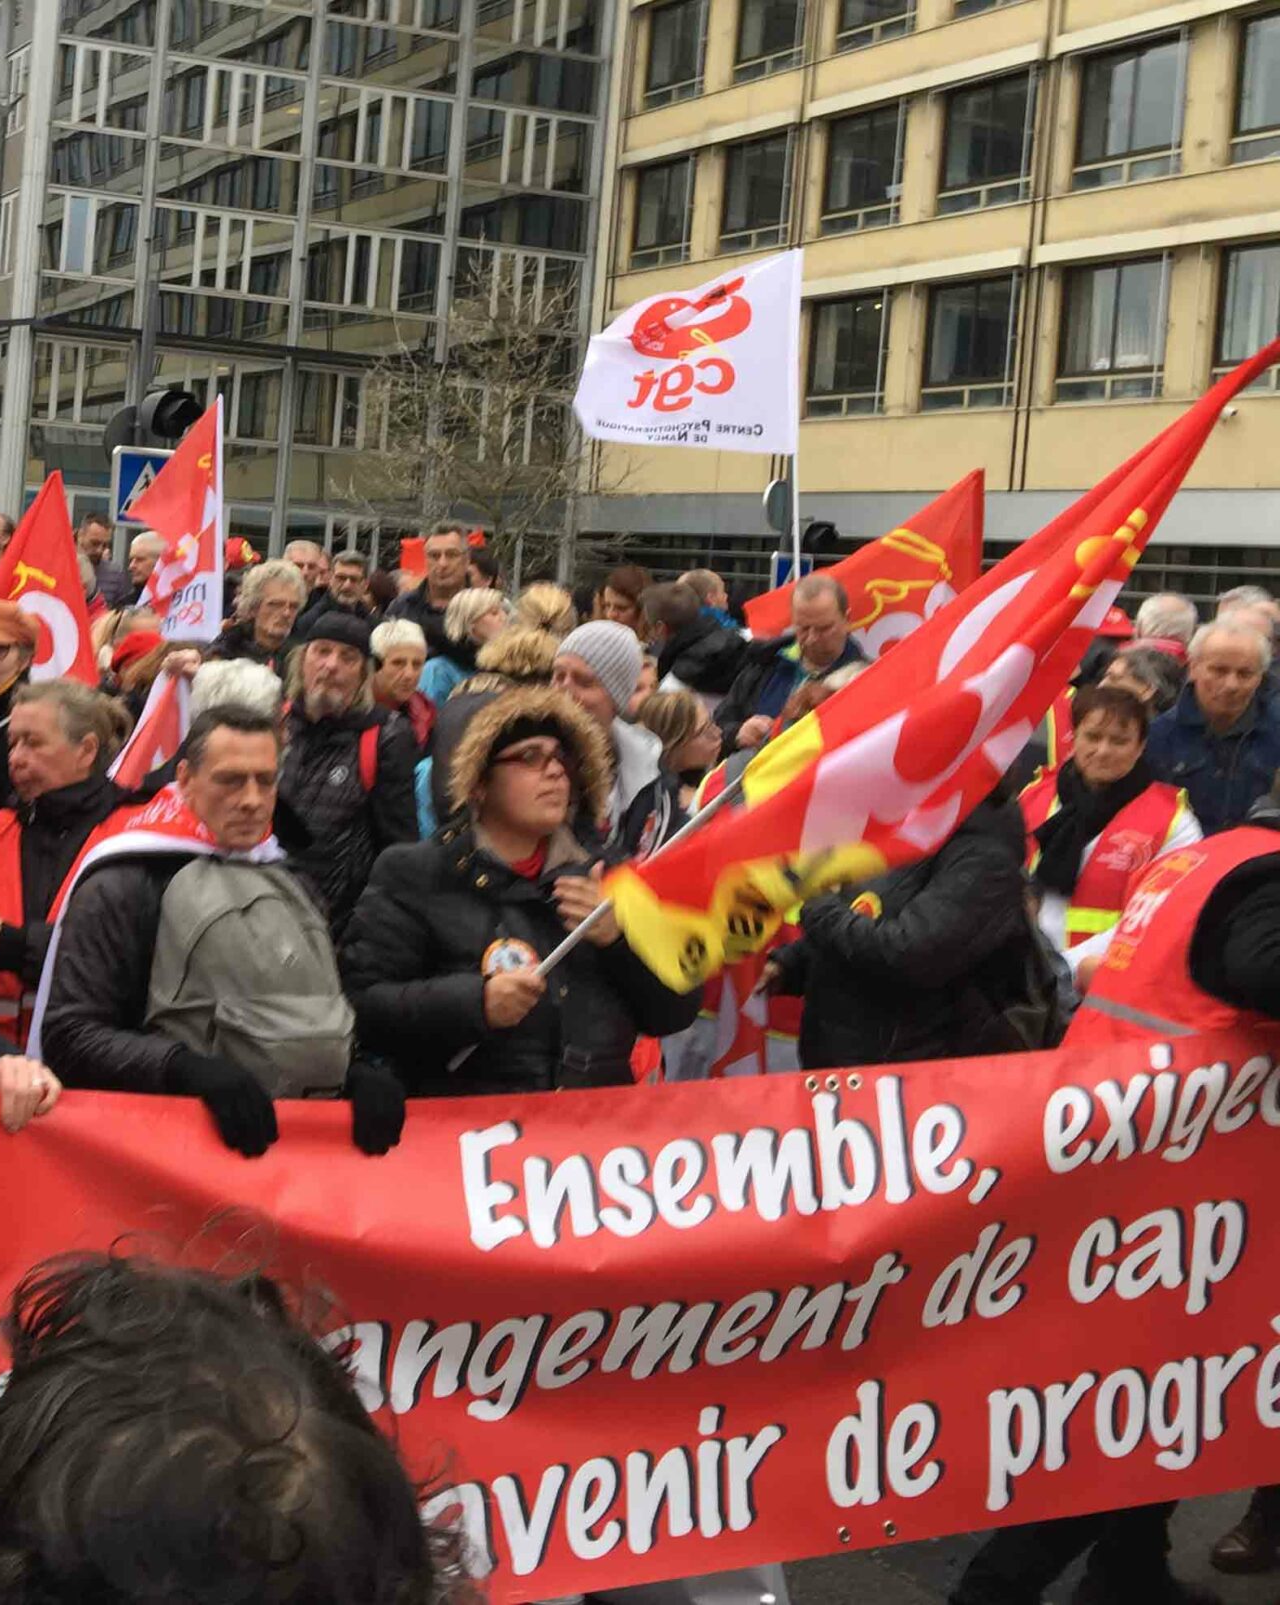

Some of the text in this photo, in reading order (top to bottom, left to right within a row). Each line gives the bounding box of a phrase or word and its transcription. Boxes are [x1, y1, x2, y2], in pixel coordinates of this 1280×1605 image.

[460, 1075, 1000, 1252] Ensemble,
[922, 1222, 1035, 1328] de
[1068, 1200, 1246, 1315] cap
[826, 1379, 942, 1509] de
